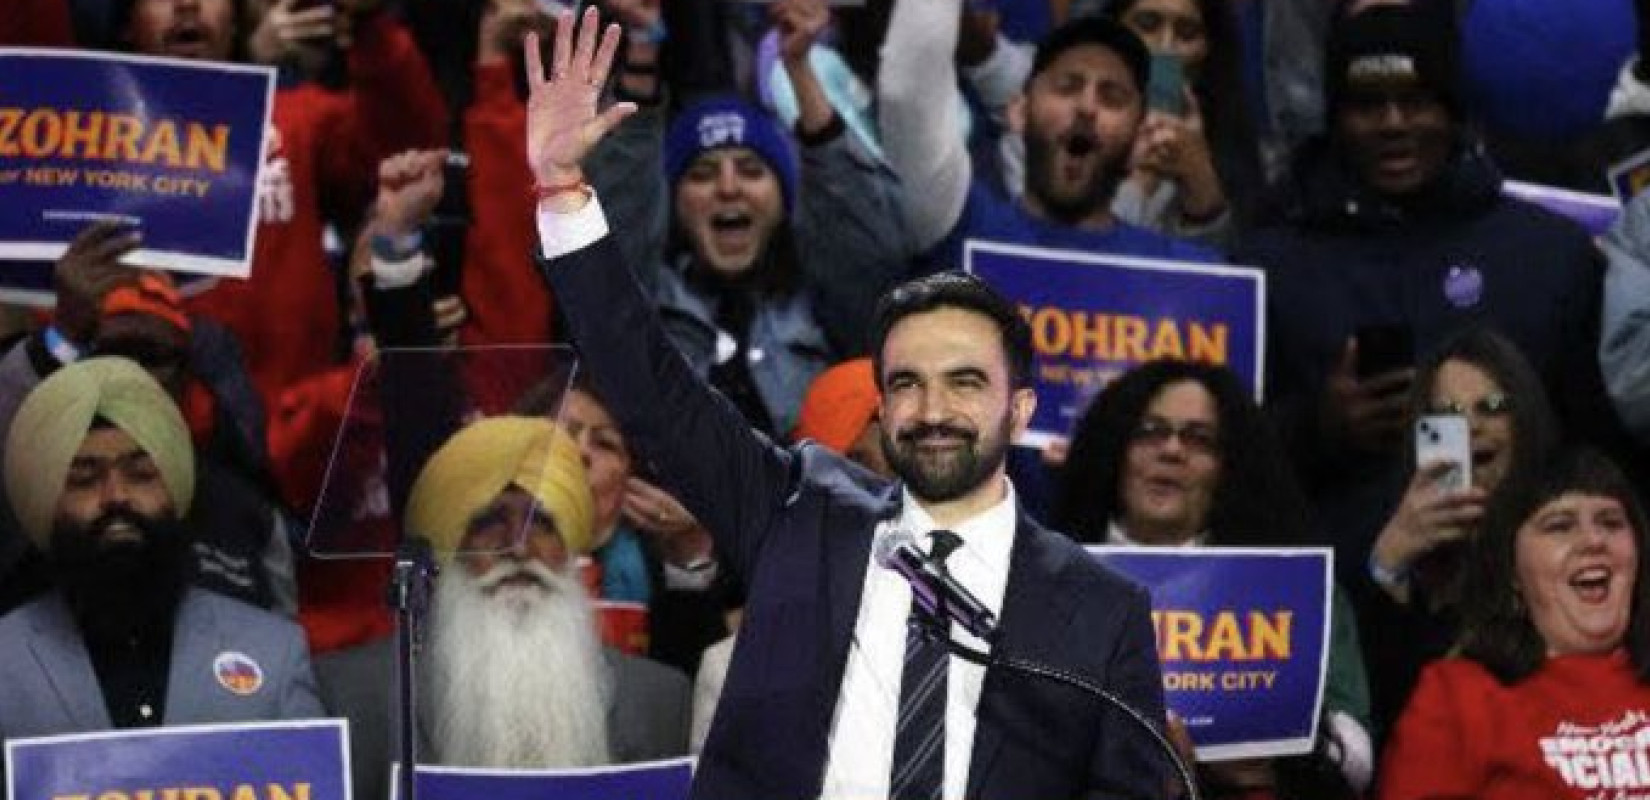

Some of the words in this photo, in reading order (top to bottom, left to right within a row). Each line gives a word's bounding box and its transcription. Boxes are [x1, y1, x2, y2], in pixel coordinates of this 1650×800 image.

[0, 108, 229, 172] ZOHRAN
[25, 167, 77, 187] NEW
[84, 170, 148, 193] YORK
[152, 176, 209, 197] CITY
[1015, 303, 1227, 364] OHRAN
[1151, 610, 1293, 662] RAN
[1163, 671, 1214, 691] ORK
[1222, 671, 1276, 689] CITY
